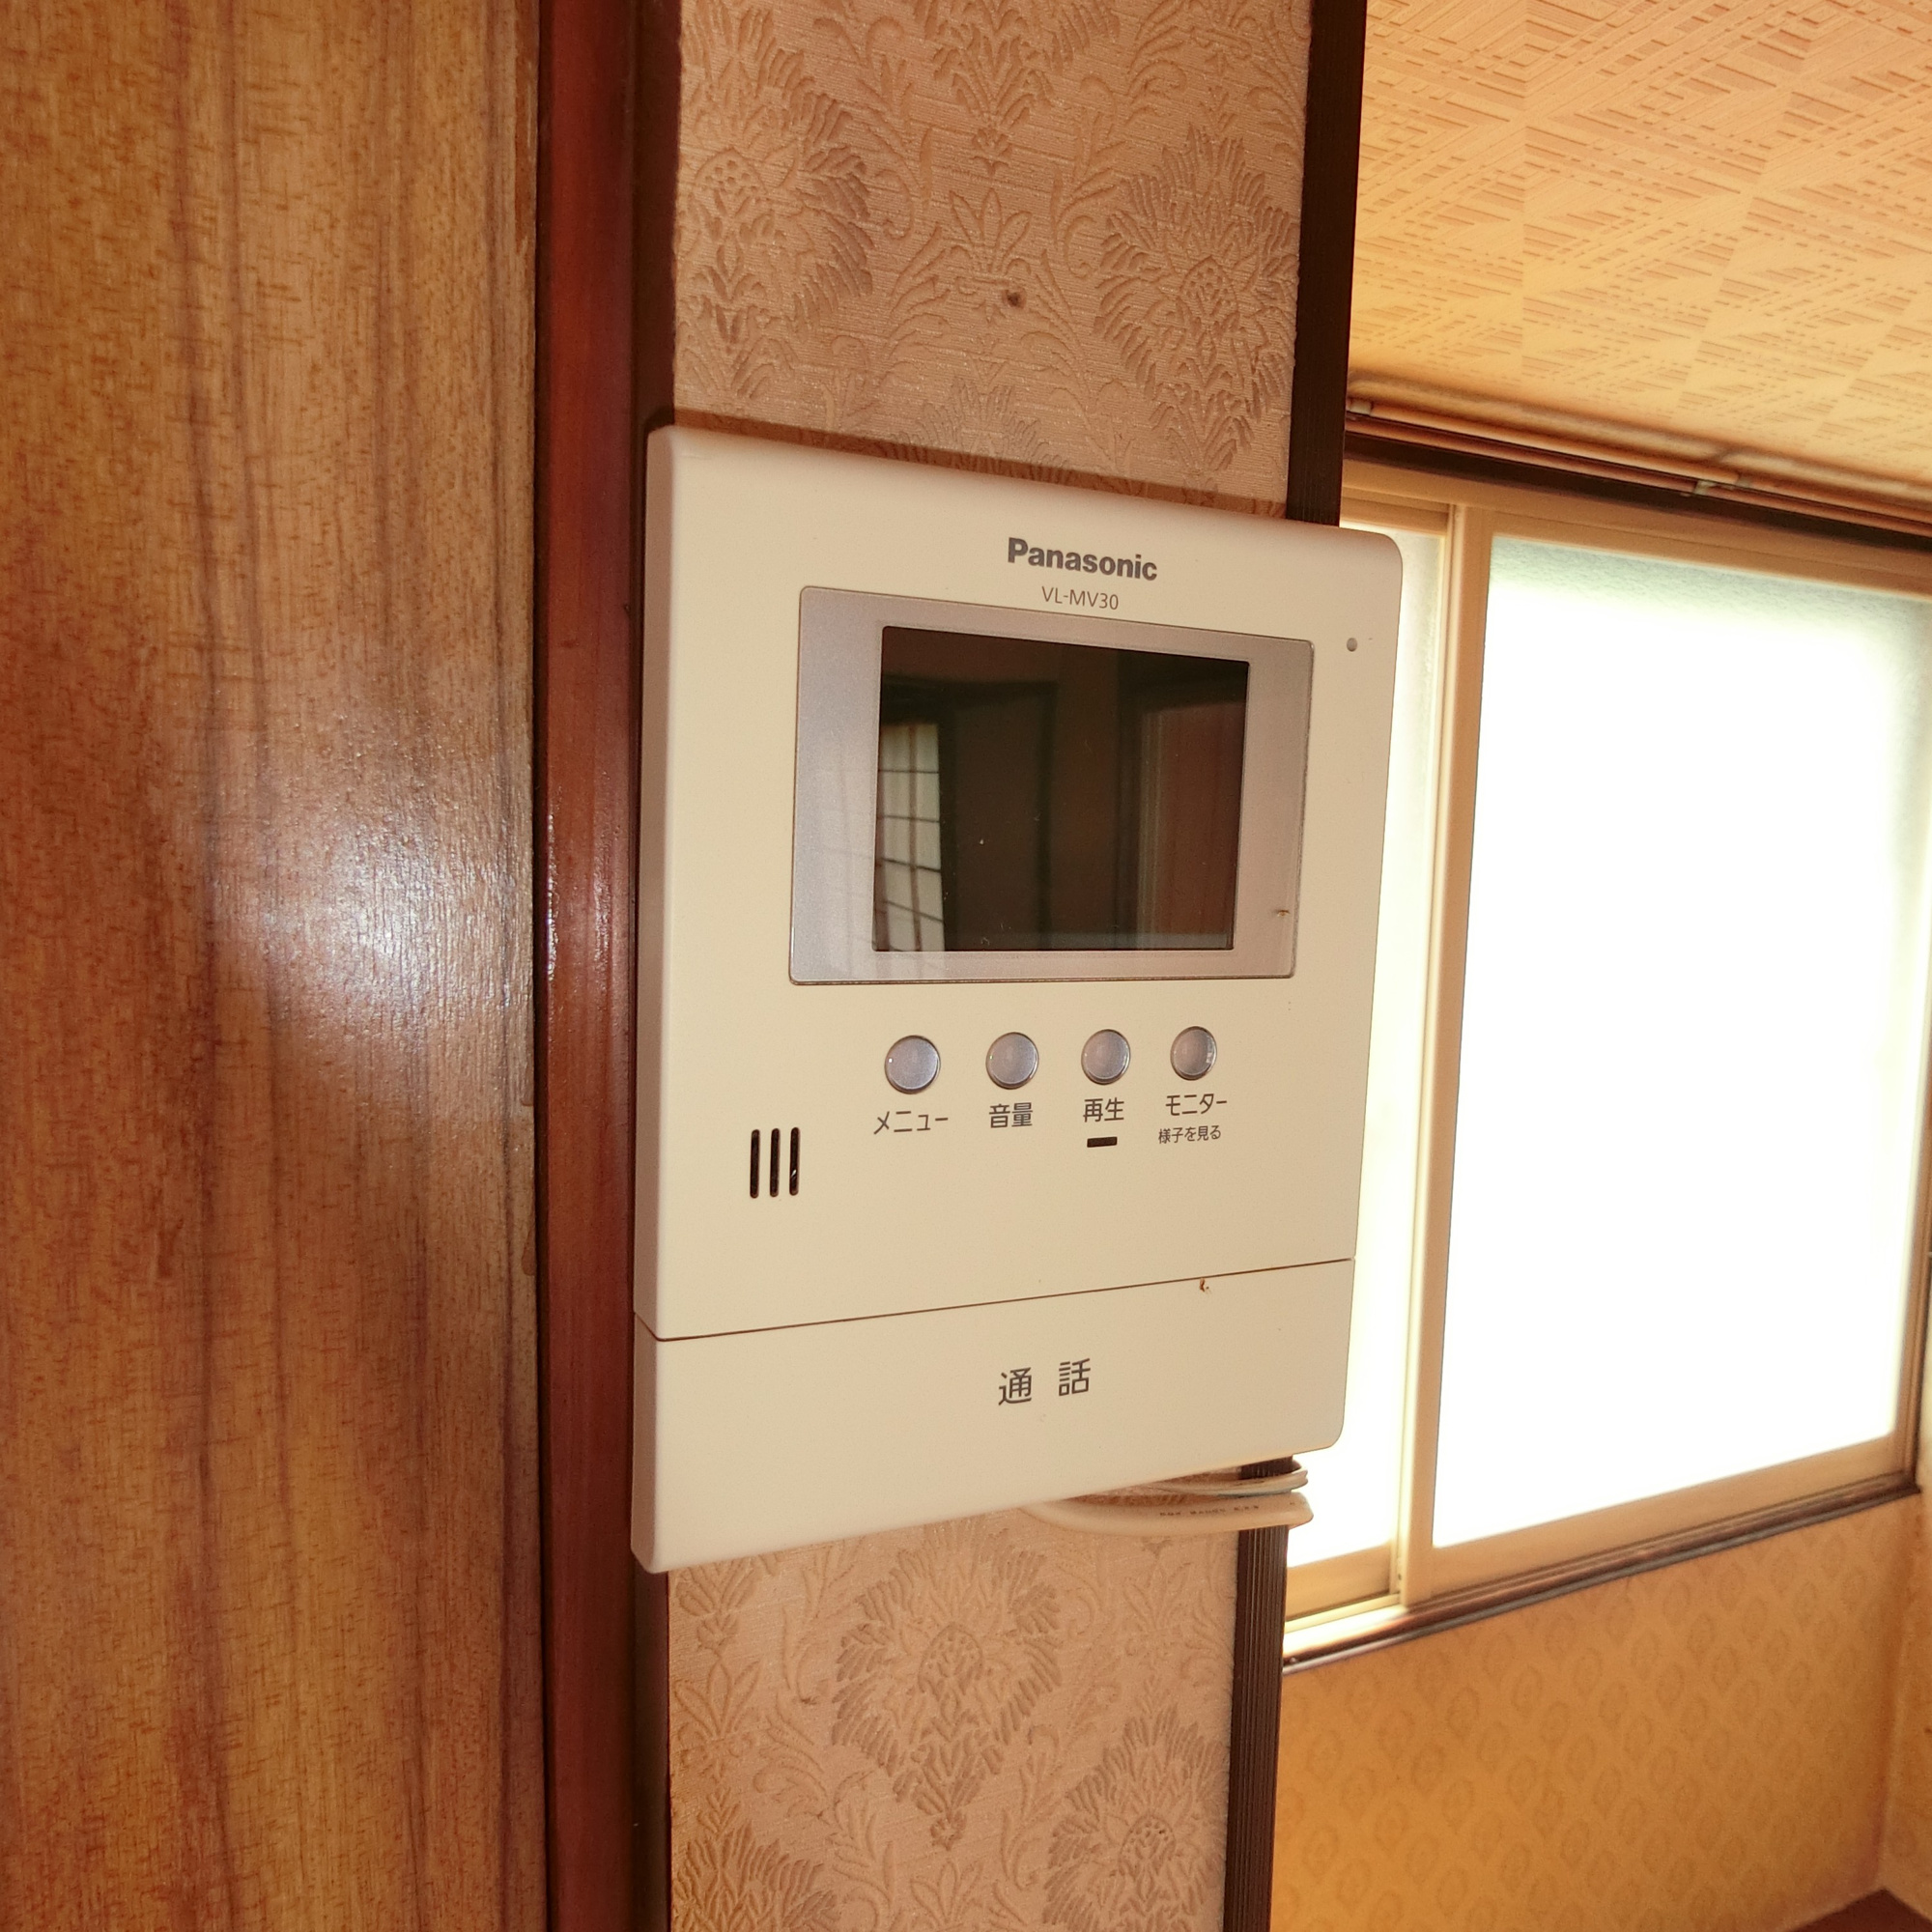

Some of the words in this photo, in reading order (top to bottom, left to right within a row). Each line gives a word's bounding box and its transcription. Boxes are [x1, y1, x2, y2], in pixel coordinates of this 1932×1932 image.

[1008, 536, 1158, 582] Panasonic
[1041, 585, 1120, 611] VL-MV30
[988, 1101, 1035, 1129] 音量
[1082, 1096, 1125, 1123] 再生
[1165, 1093, 1229, 1117] モニター
[873, 1110, 950, 1135] メニュー
[1157, 1124, 1222, 1146] 様子を見る
[998, 1357, 1092, 1406] 通話
